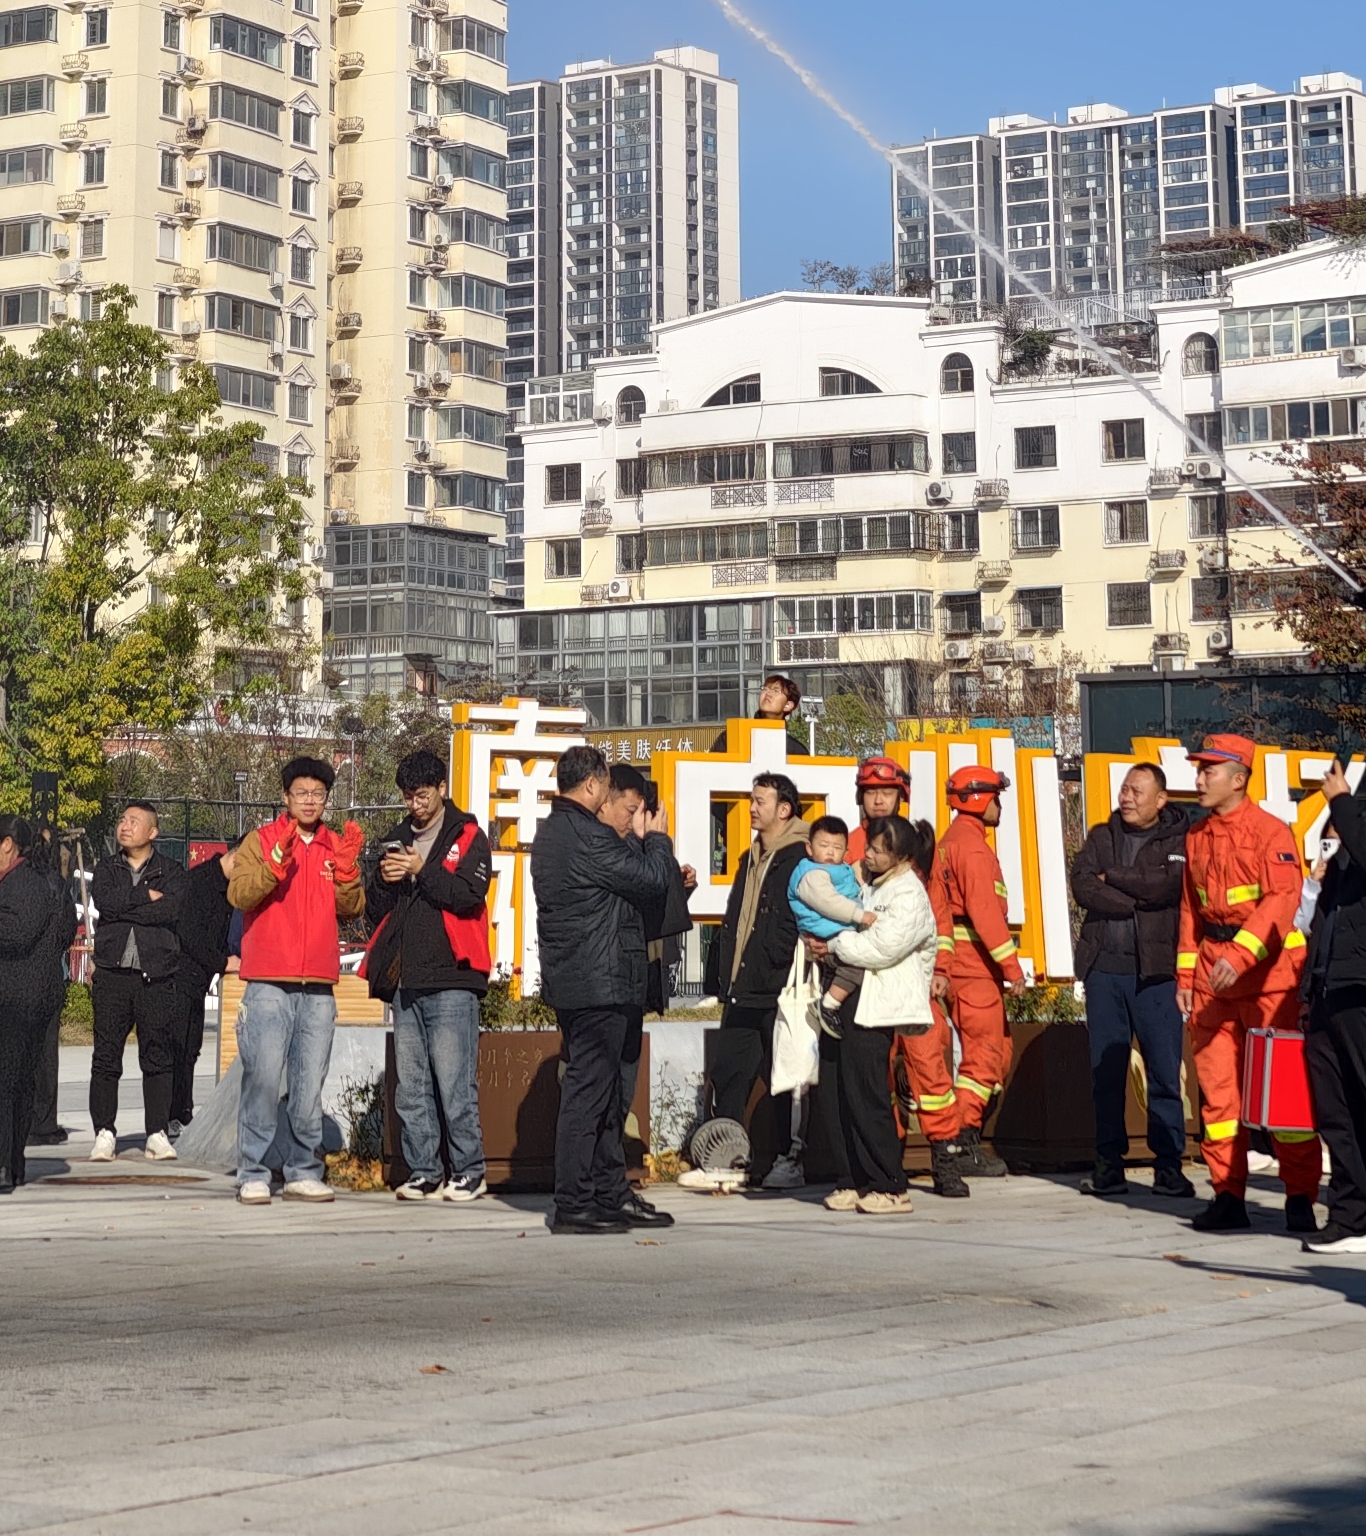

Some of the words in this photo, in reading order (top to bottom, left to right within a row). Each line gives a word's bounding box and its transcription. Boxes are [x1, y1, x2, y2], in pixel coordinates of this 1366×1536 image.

[586, 737, 694, 763] 能美肤纤体
